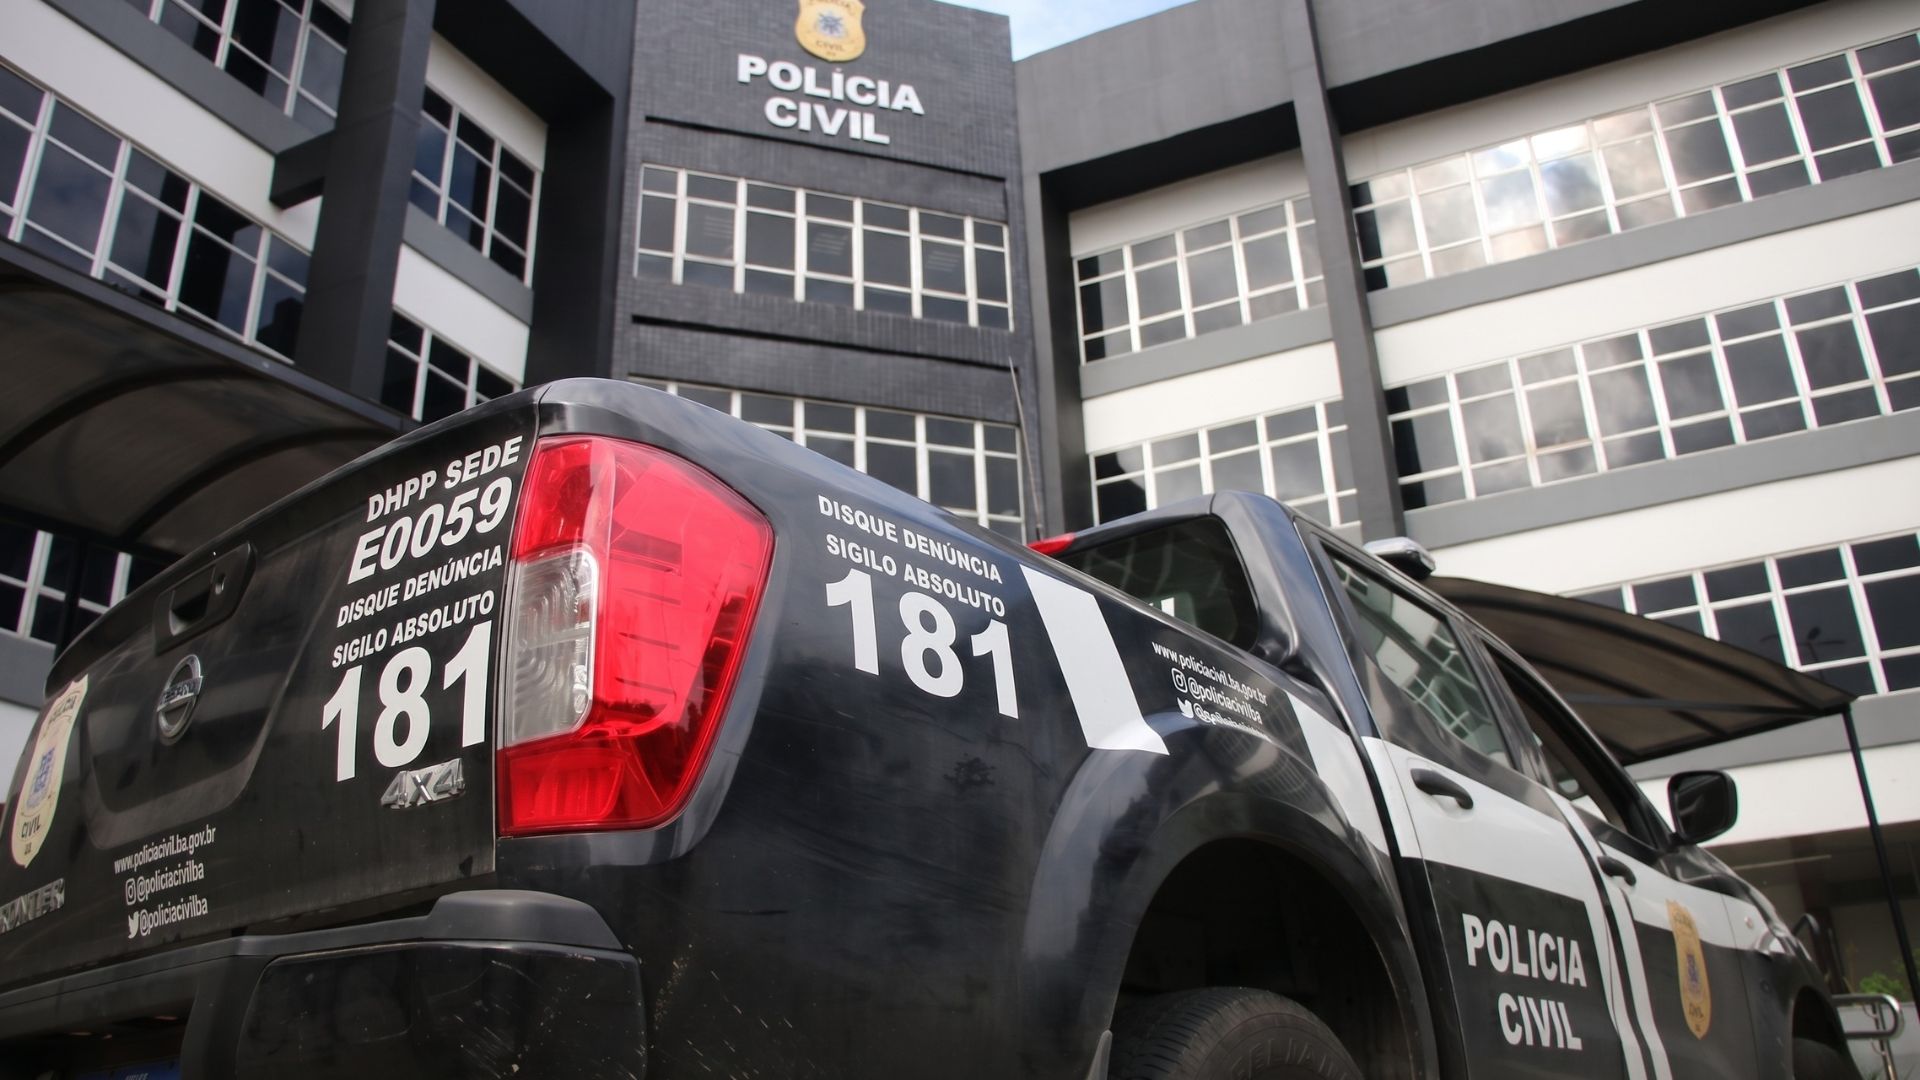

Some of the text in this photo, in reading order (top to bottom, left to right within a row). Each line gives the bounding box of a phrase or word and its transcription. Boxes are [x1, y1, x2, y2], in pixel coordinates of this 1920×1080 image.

[737, 54, 925, 116] POLÍCIA
[764, 97, 891, 145] CIVIL
[366, 436, 523, 523] DHPP SEDE
[347, 476, 513, 585] E0059
[818, 495, 1003, 584] DISQUE DENÚNCIA
[337, 545, 502, 628] DISQUE DENÚNCIA
[826, 534, 1006, 617] SIGILO ABSOLUTO
[332, 590, 494, 668] SIGILO ABSOLUTO
[825, 568, 1019, 720] 181
[322, 620, 493, 782] 181
[1151, 641, 1268, 706] www.policiacivil.ba.gov.br
[114, 823, 216, 875] www.policiacivil.ba.gov.br
[136, 862, 204, 902] @policiacivilba
[139, 896, 208, 936] @policiacivilba
[1462, 913, 1587, 987] POLICIA
[1498, 992, 1583, 1051] CIVIL
